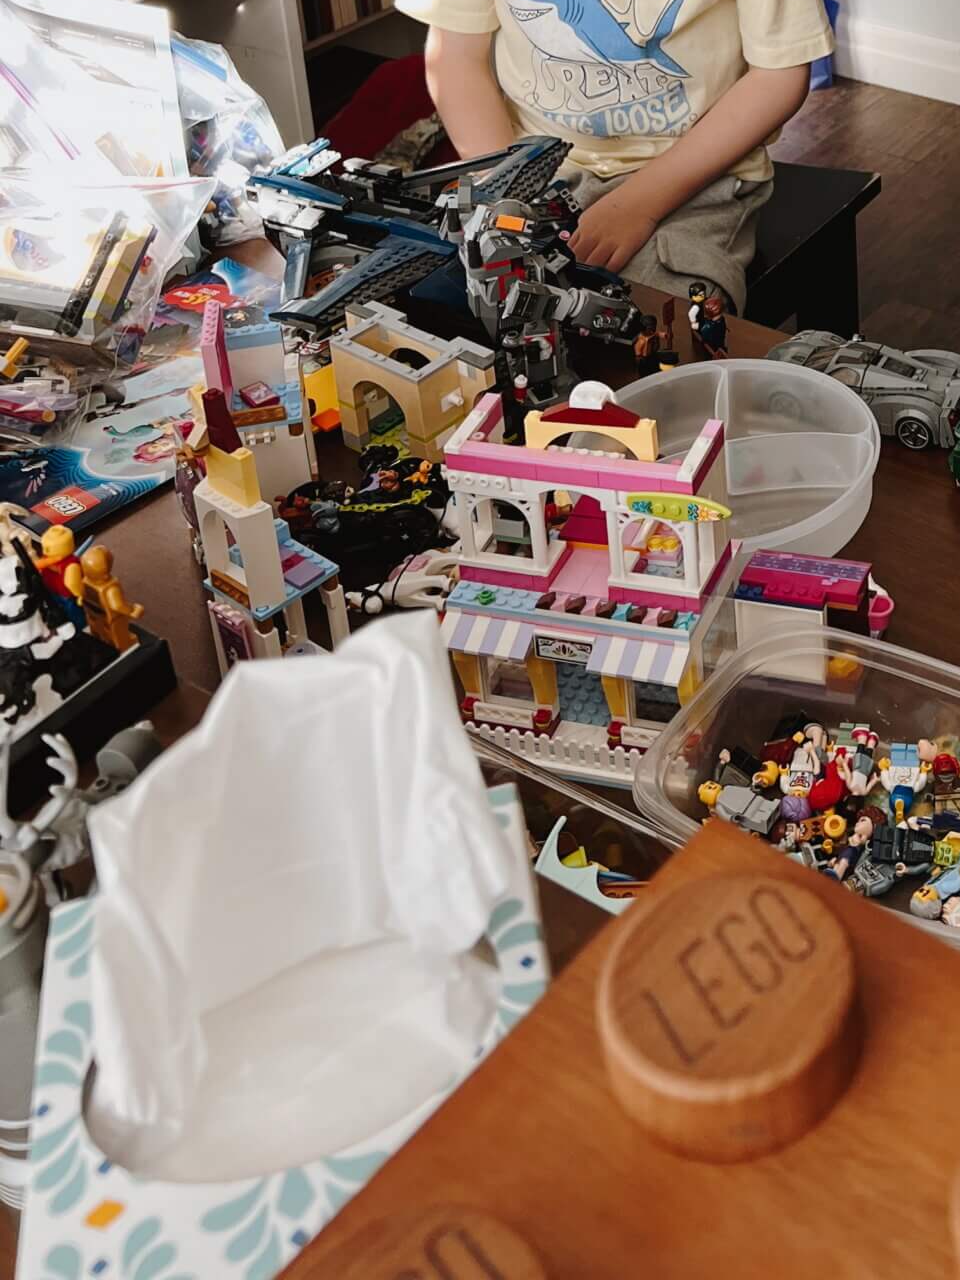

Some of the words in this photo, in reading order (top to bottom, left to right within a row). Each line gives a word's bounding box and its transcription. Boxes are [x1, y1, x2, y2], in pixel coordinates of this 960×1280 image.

[604, 92, 690, 137] LOOSE
[46, 496, 84, 515] LEGO
[642, 885, 817, 1063] LEGO
